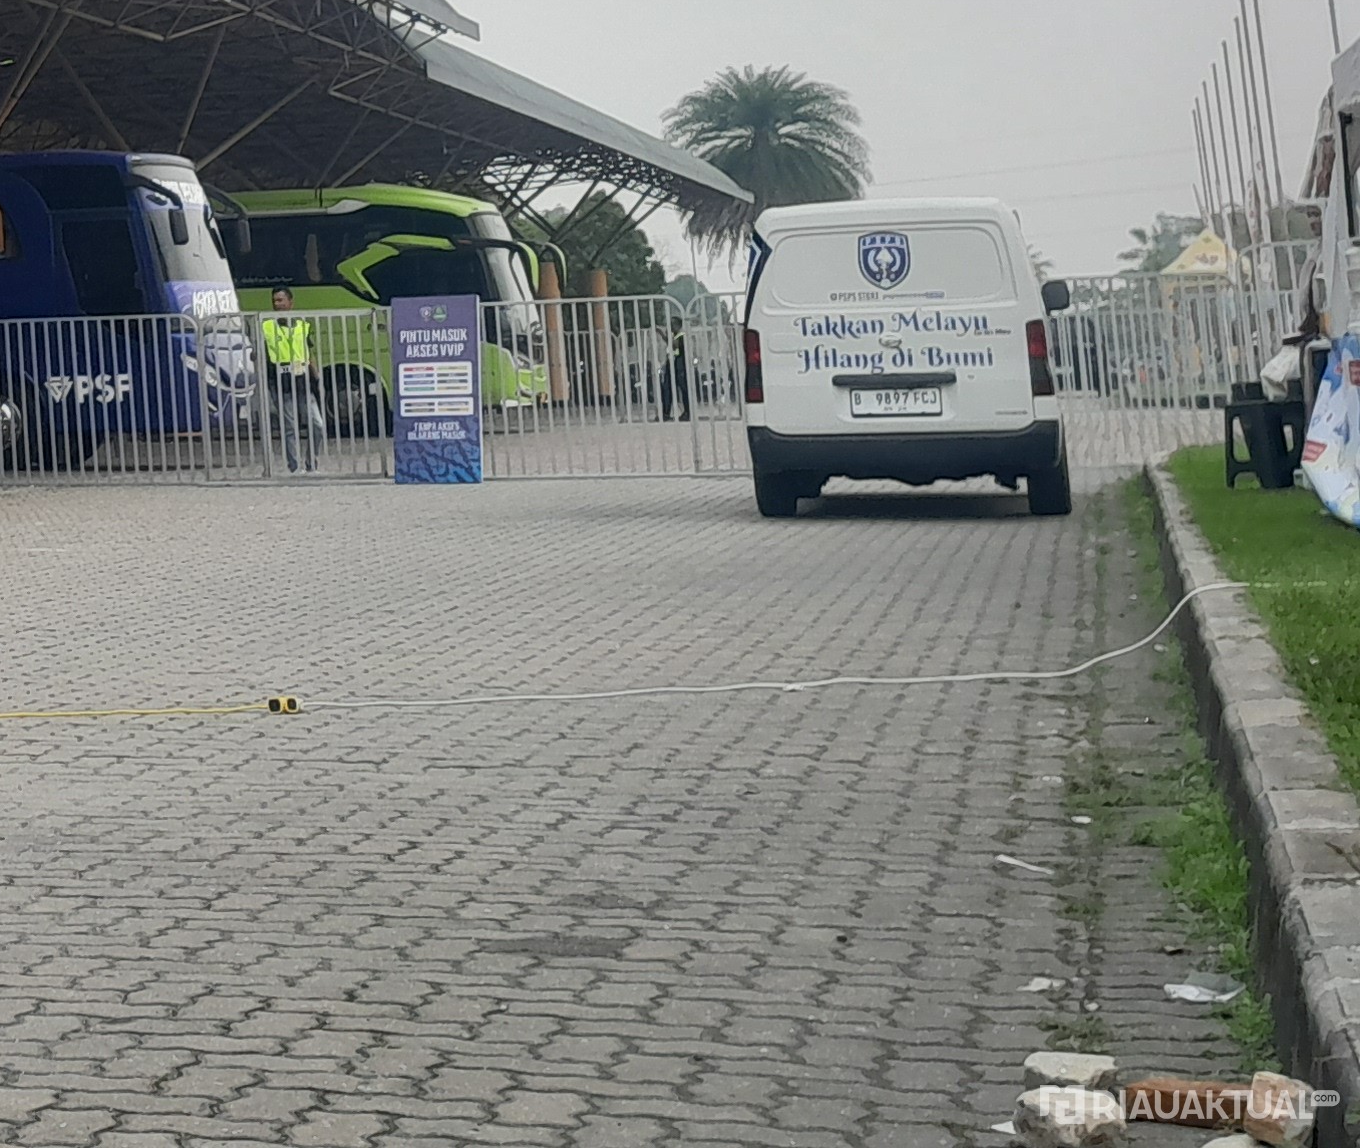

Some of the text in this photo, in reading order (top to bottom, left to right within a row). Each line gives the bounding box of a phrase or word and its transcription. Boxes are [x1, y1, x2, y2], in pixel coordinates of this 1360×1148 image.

[793, 308, 989, 339] Takkan Melayu
[399, 328, 468, 343] PINTU MASUK
[406, 343, 465, 358] AKSES VVIP
[797, 344, 885, 374] Hilang
[920, 347, 994, 368] Bumi
[76, 373, 132, 404] PSF
[854, 393, 861, 405] B
